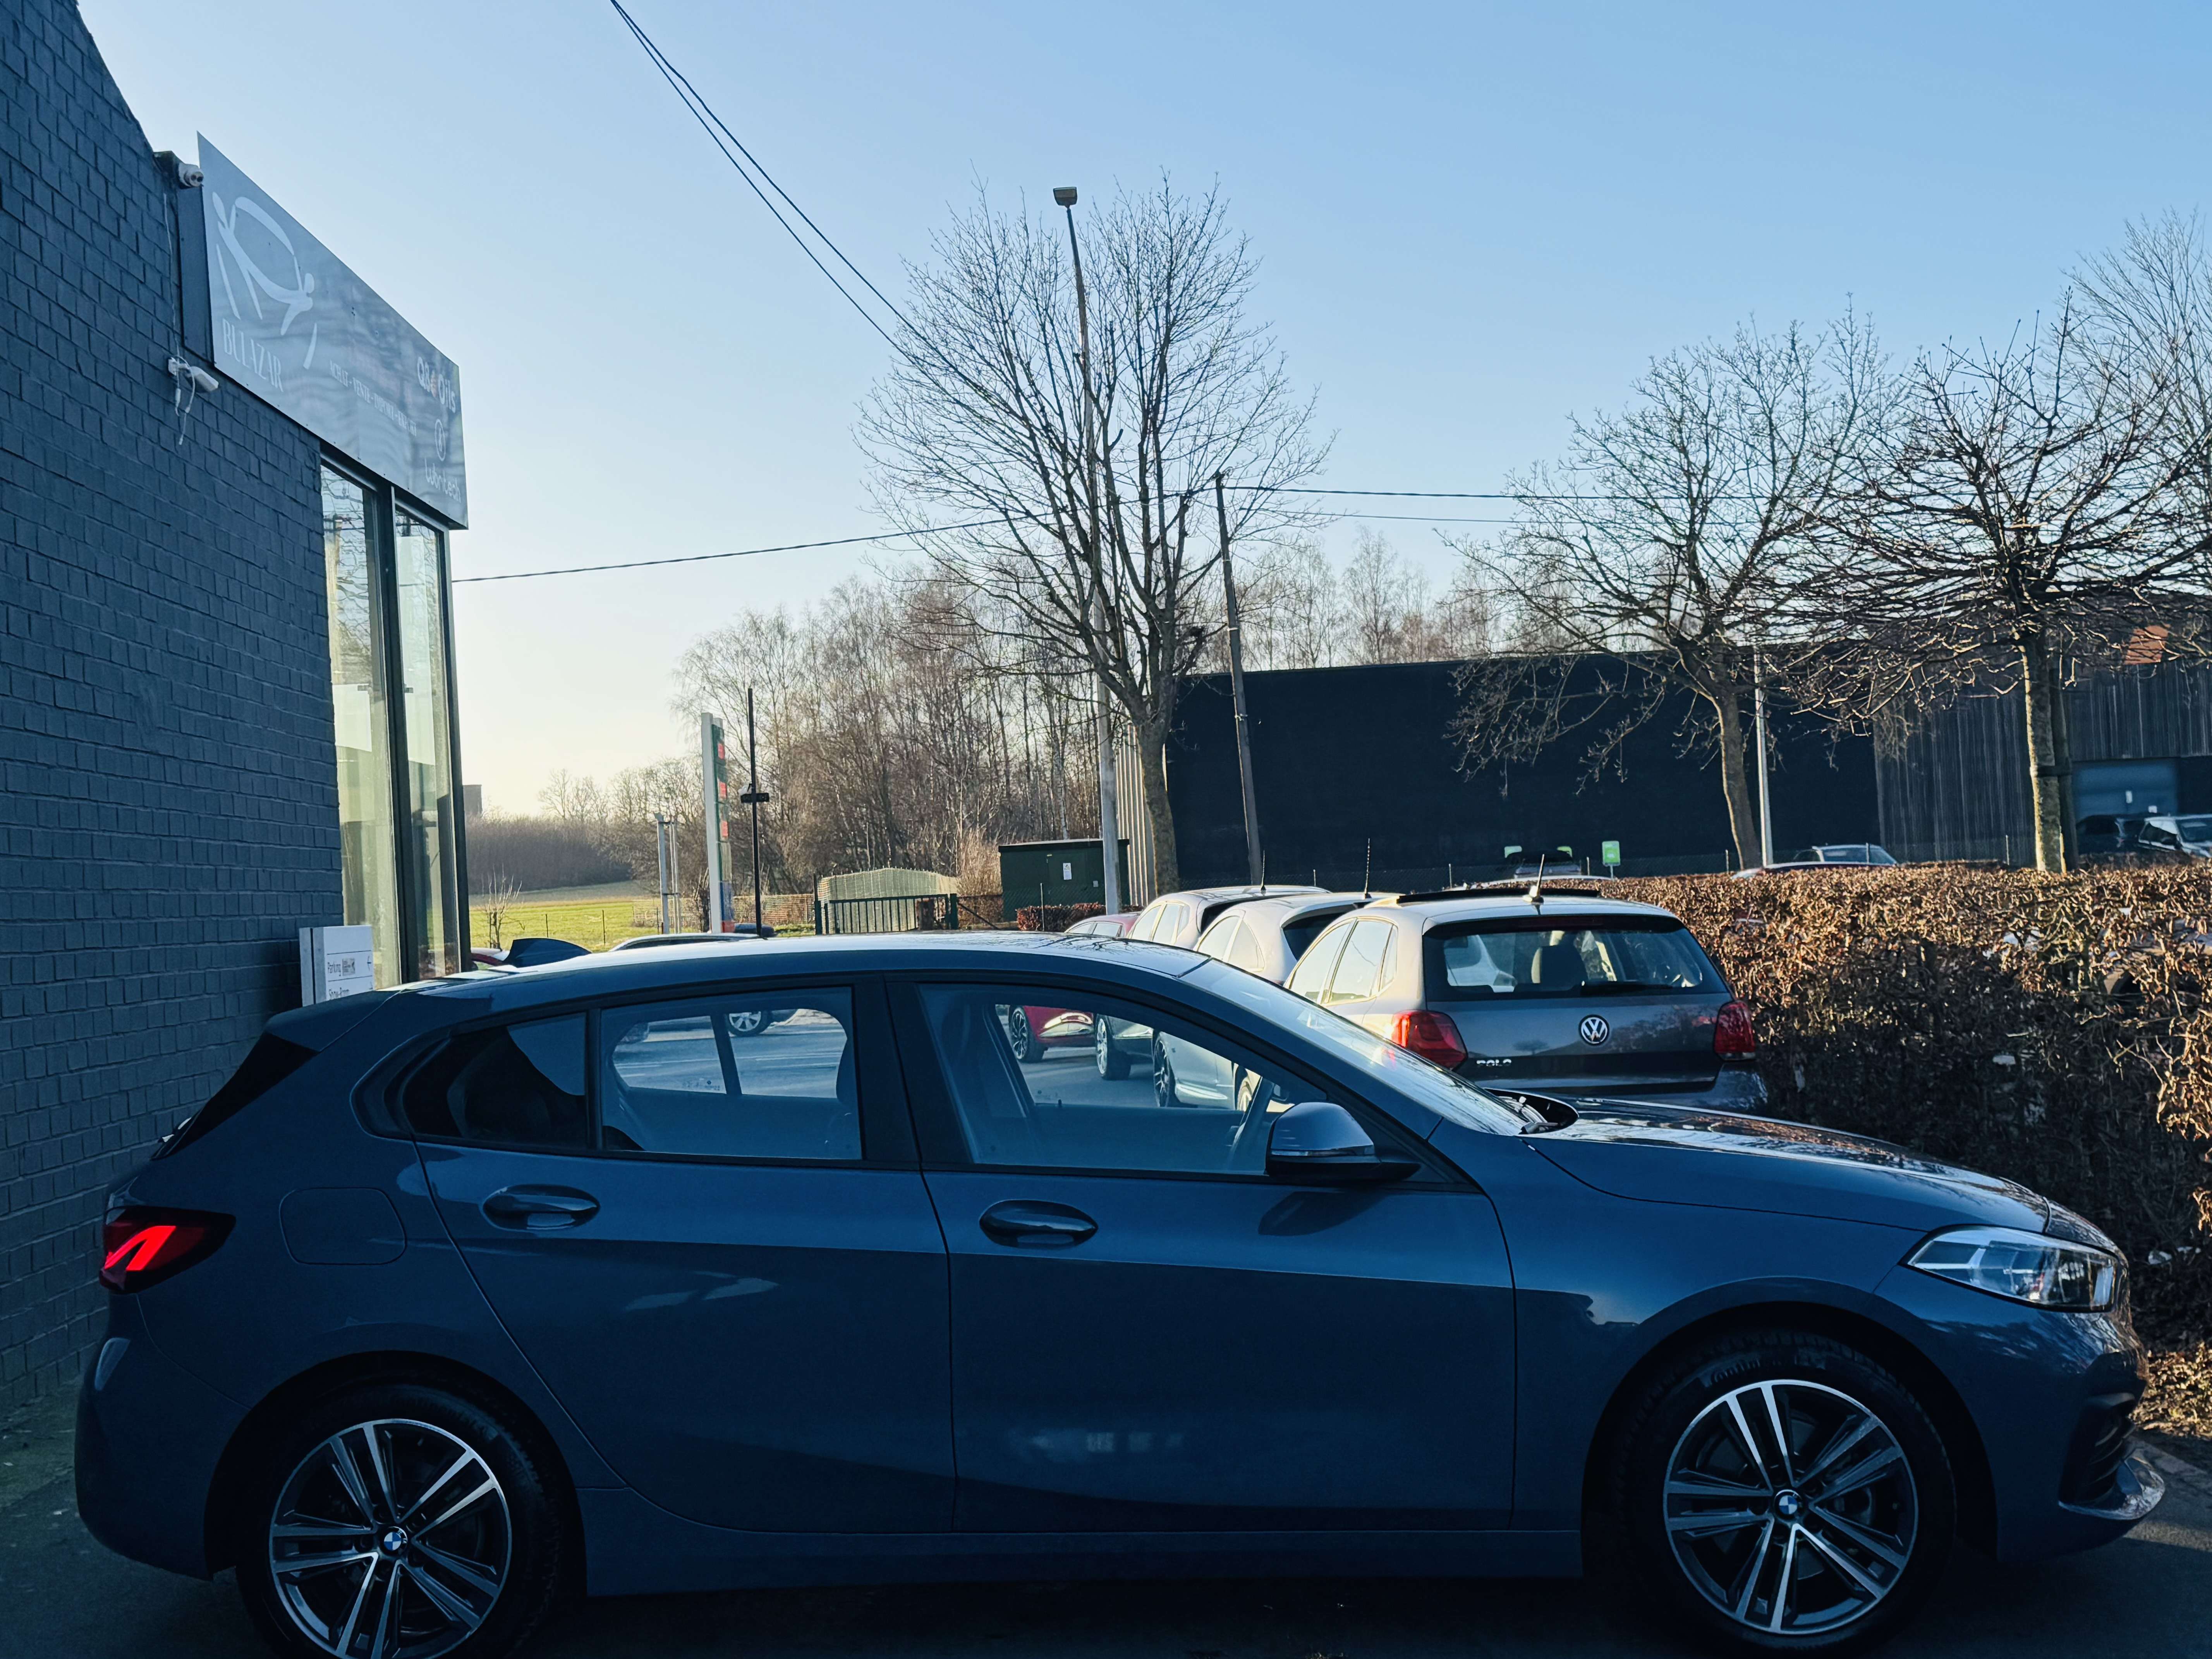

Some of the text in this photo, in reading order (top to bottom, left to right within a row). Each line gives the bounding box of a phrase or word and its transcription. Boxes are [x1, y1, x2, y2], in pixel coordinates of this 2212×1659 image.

[417, 356, 456, 413] Q8 Oils
[327, 962, 341, 976] Parking
